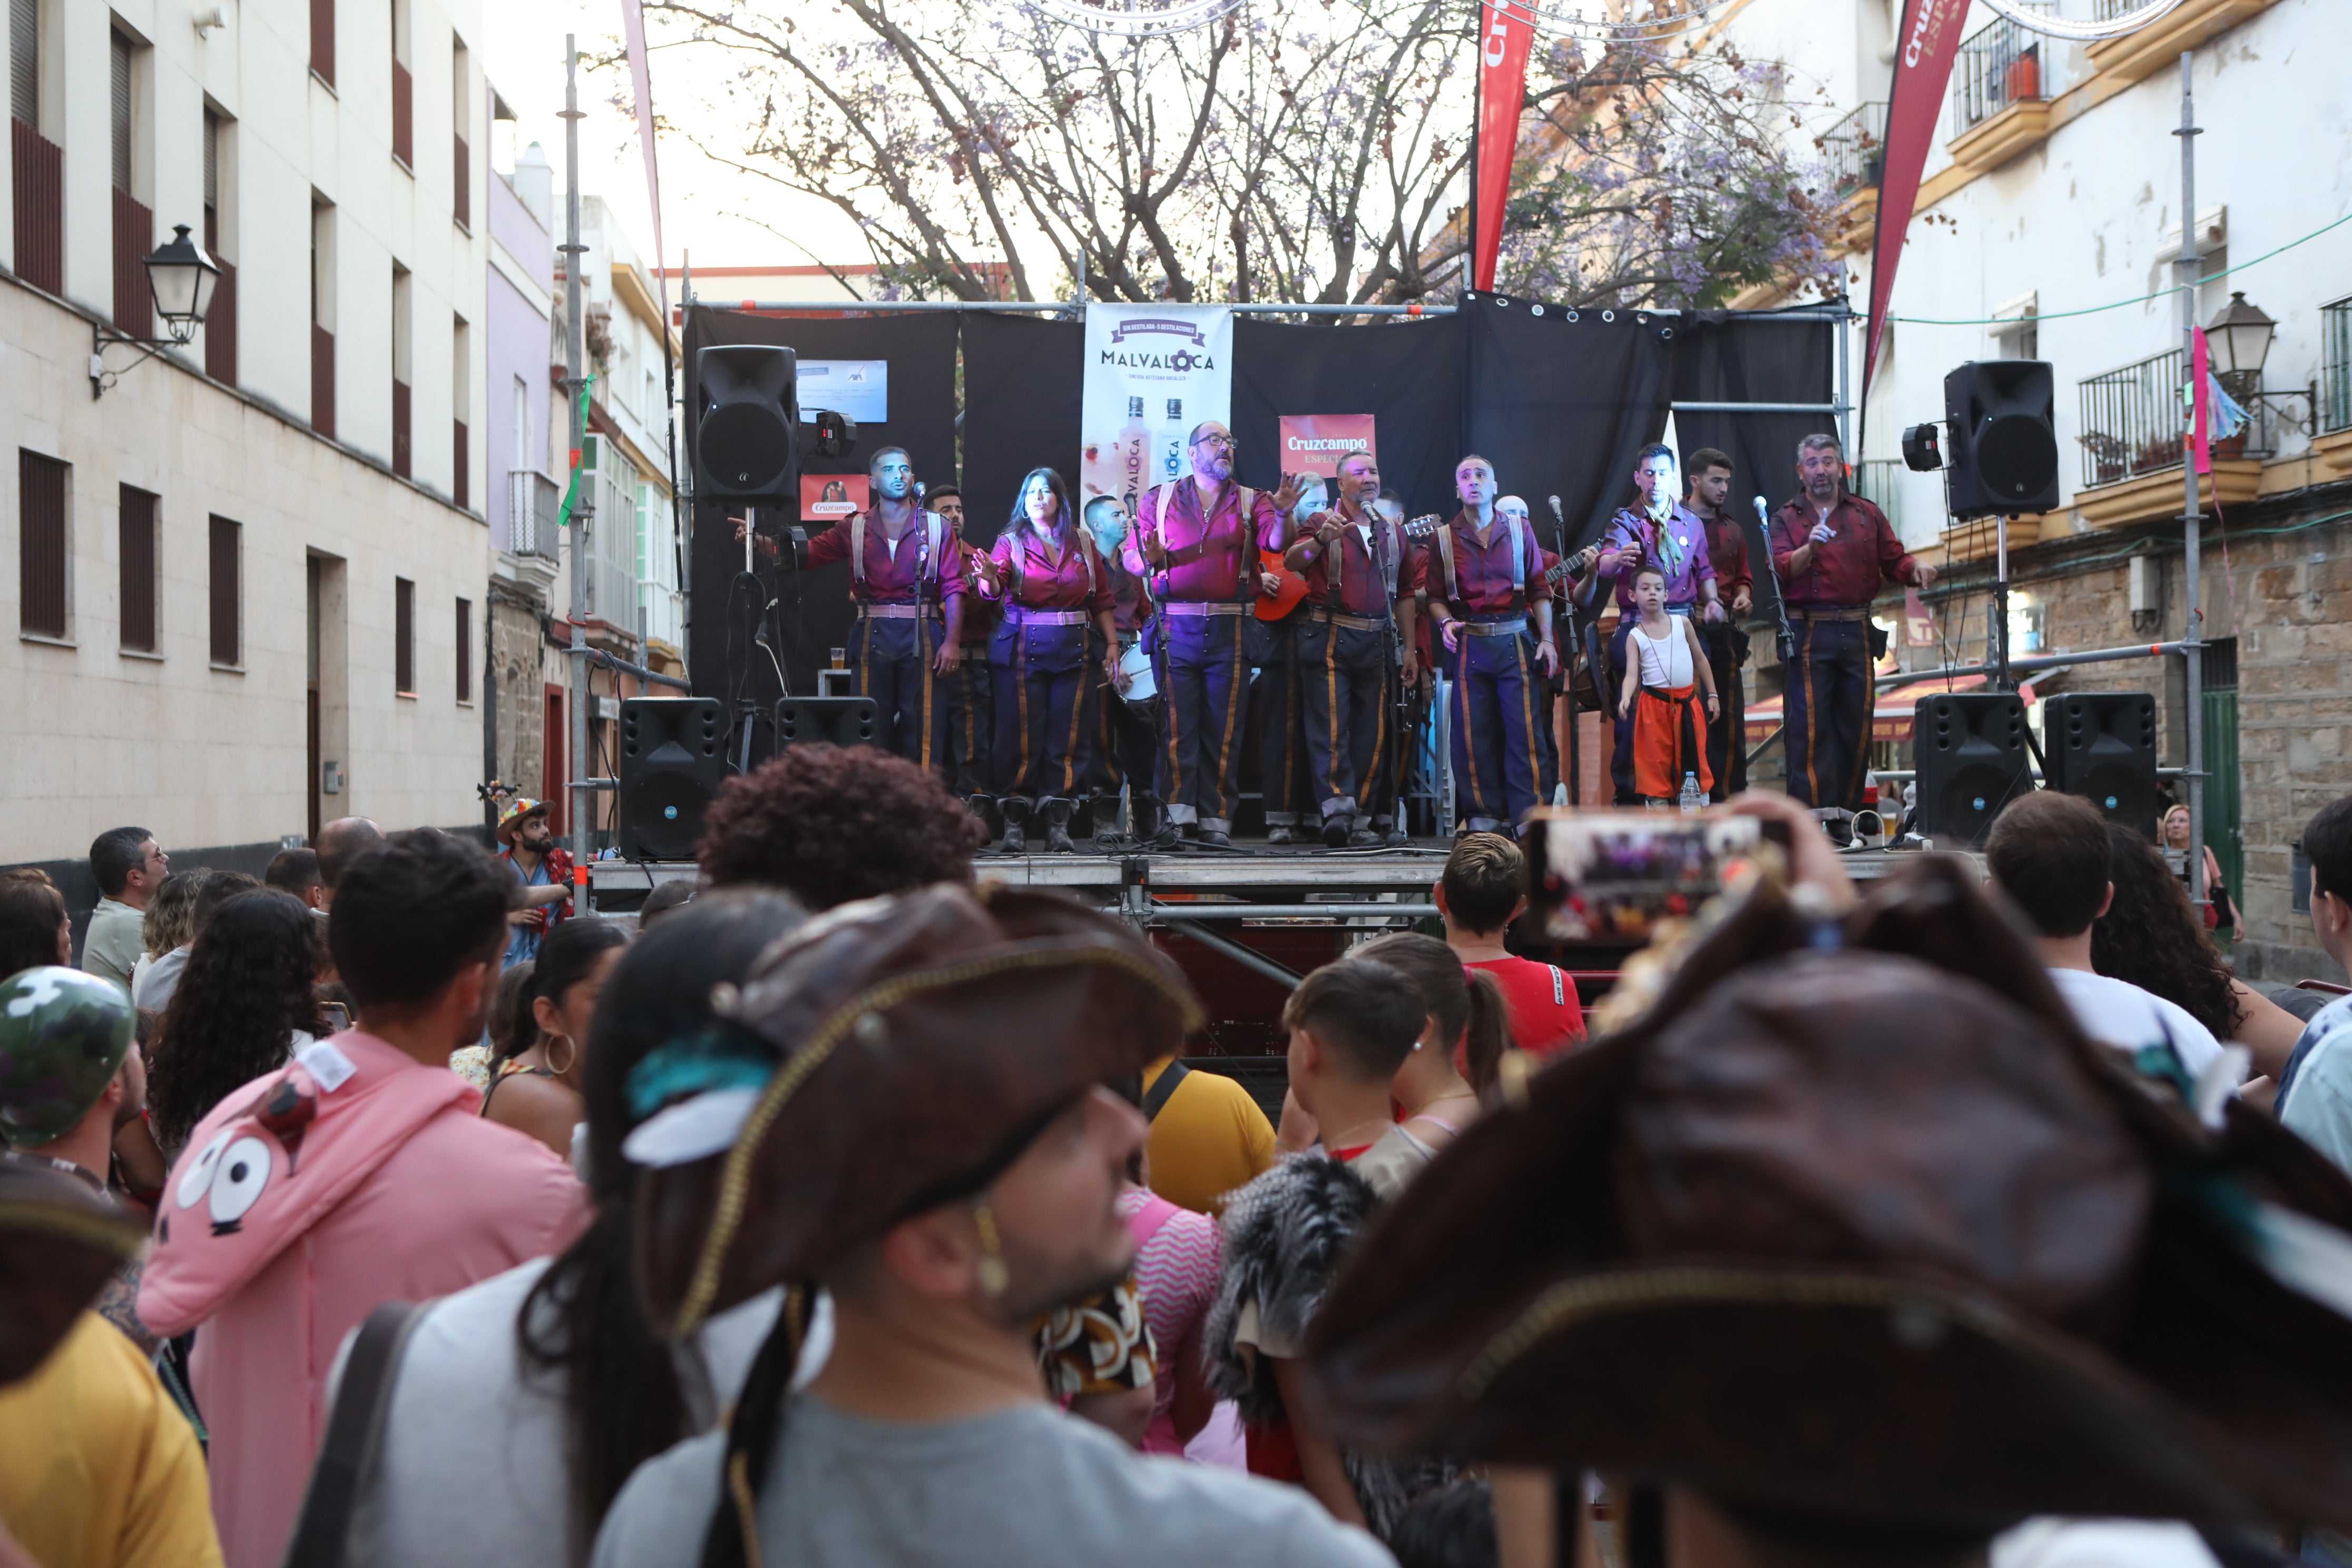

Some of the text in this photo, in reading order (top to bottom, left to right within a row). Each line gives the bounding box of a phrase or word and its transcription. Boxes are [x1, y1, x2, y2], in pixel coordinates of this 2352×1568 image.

[1161, 324, 1194, 333] DESTILACIONES
[1101, 349, 1214, 370] MALVALOCA
[1288, 436, 1367, 452] Cruzcampo
[1305, 454, 1343, 463] ESPECI
